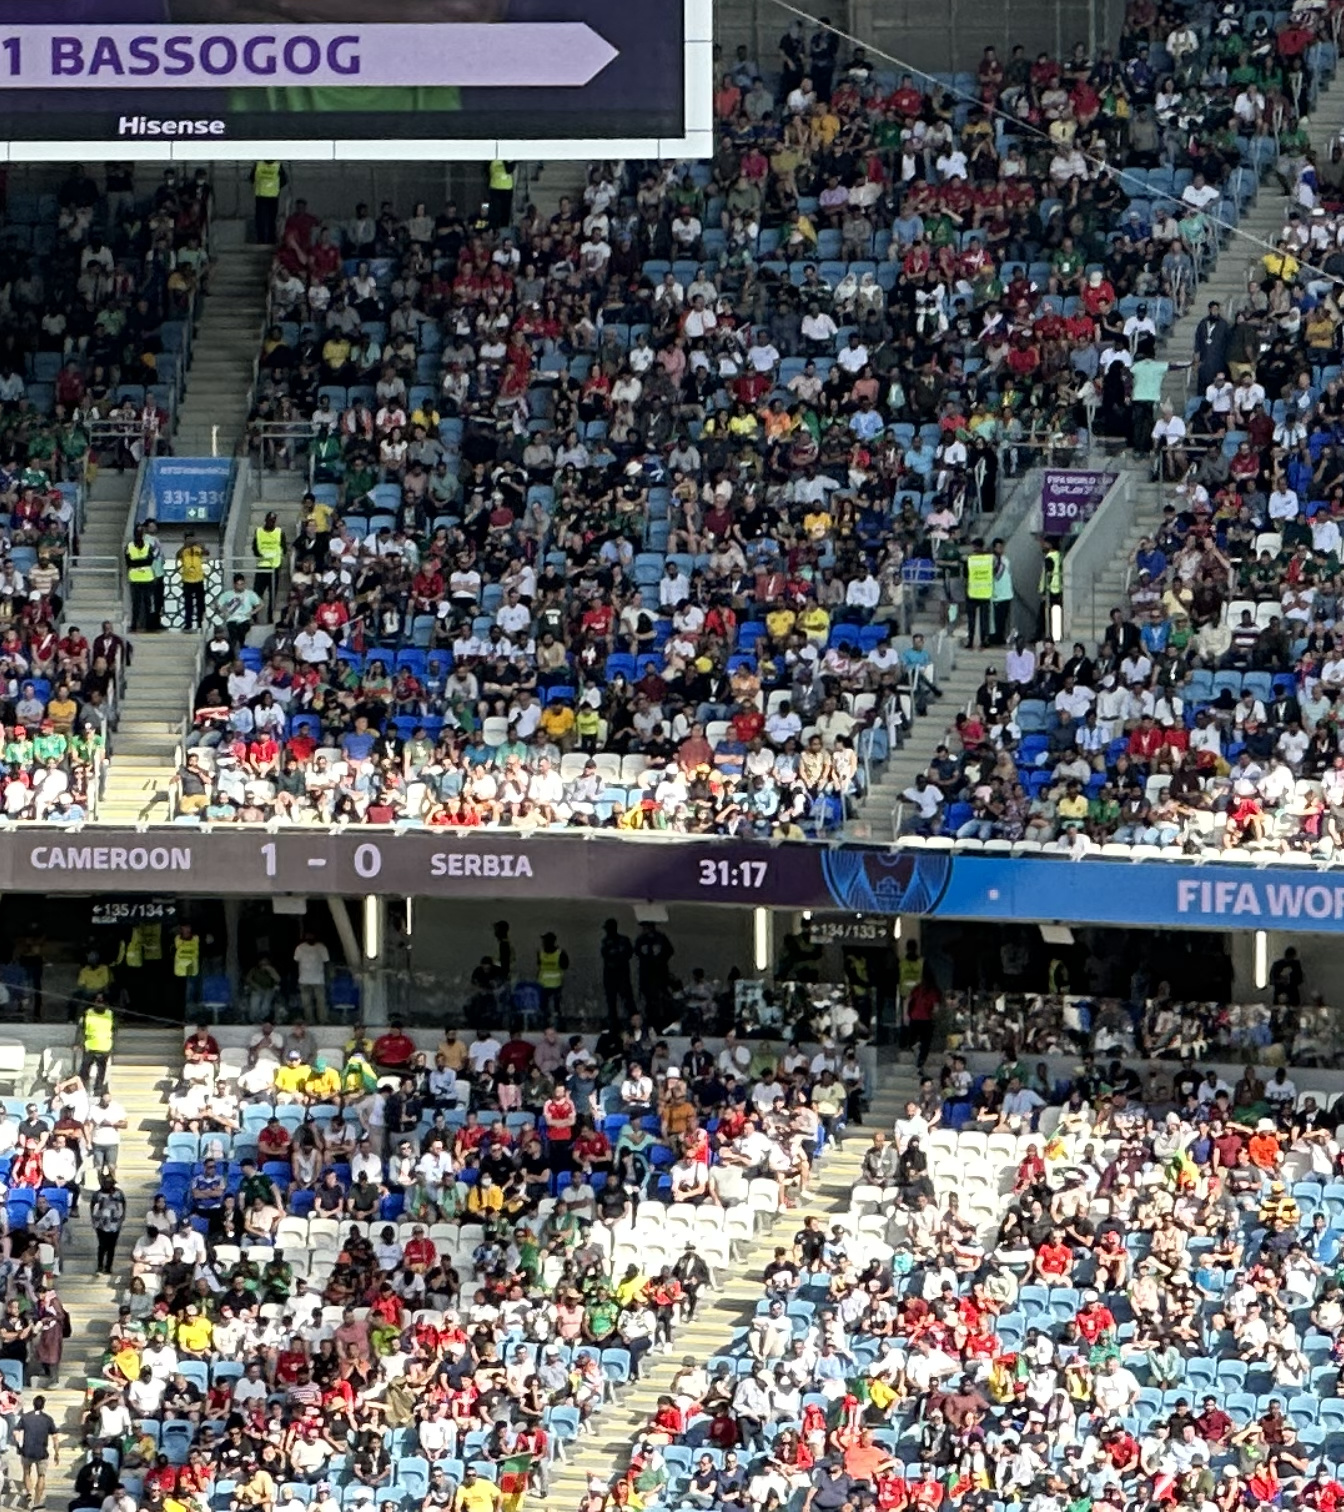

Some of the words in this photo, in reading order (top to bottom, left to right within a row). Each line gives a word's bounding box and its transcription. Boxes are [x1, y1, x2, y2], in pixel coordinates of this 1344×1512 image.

[51, 34, 361, 76] BASSOGOG
[118, 115, 226, 136] Hisense
[30, 846, 192, 871] CAMEROON
[260, 842, 277, 877] 1
[353, 842, 383, 879] 0
[430, 852, 534, 878] SERBIA
[699, 859, 768, 888] 31:17
[1176, 879, 1262, 916] FIFA
